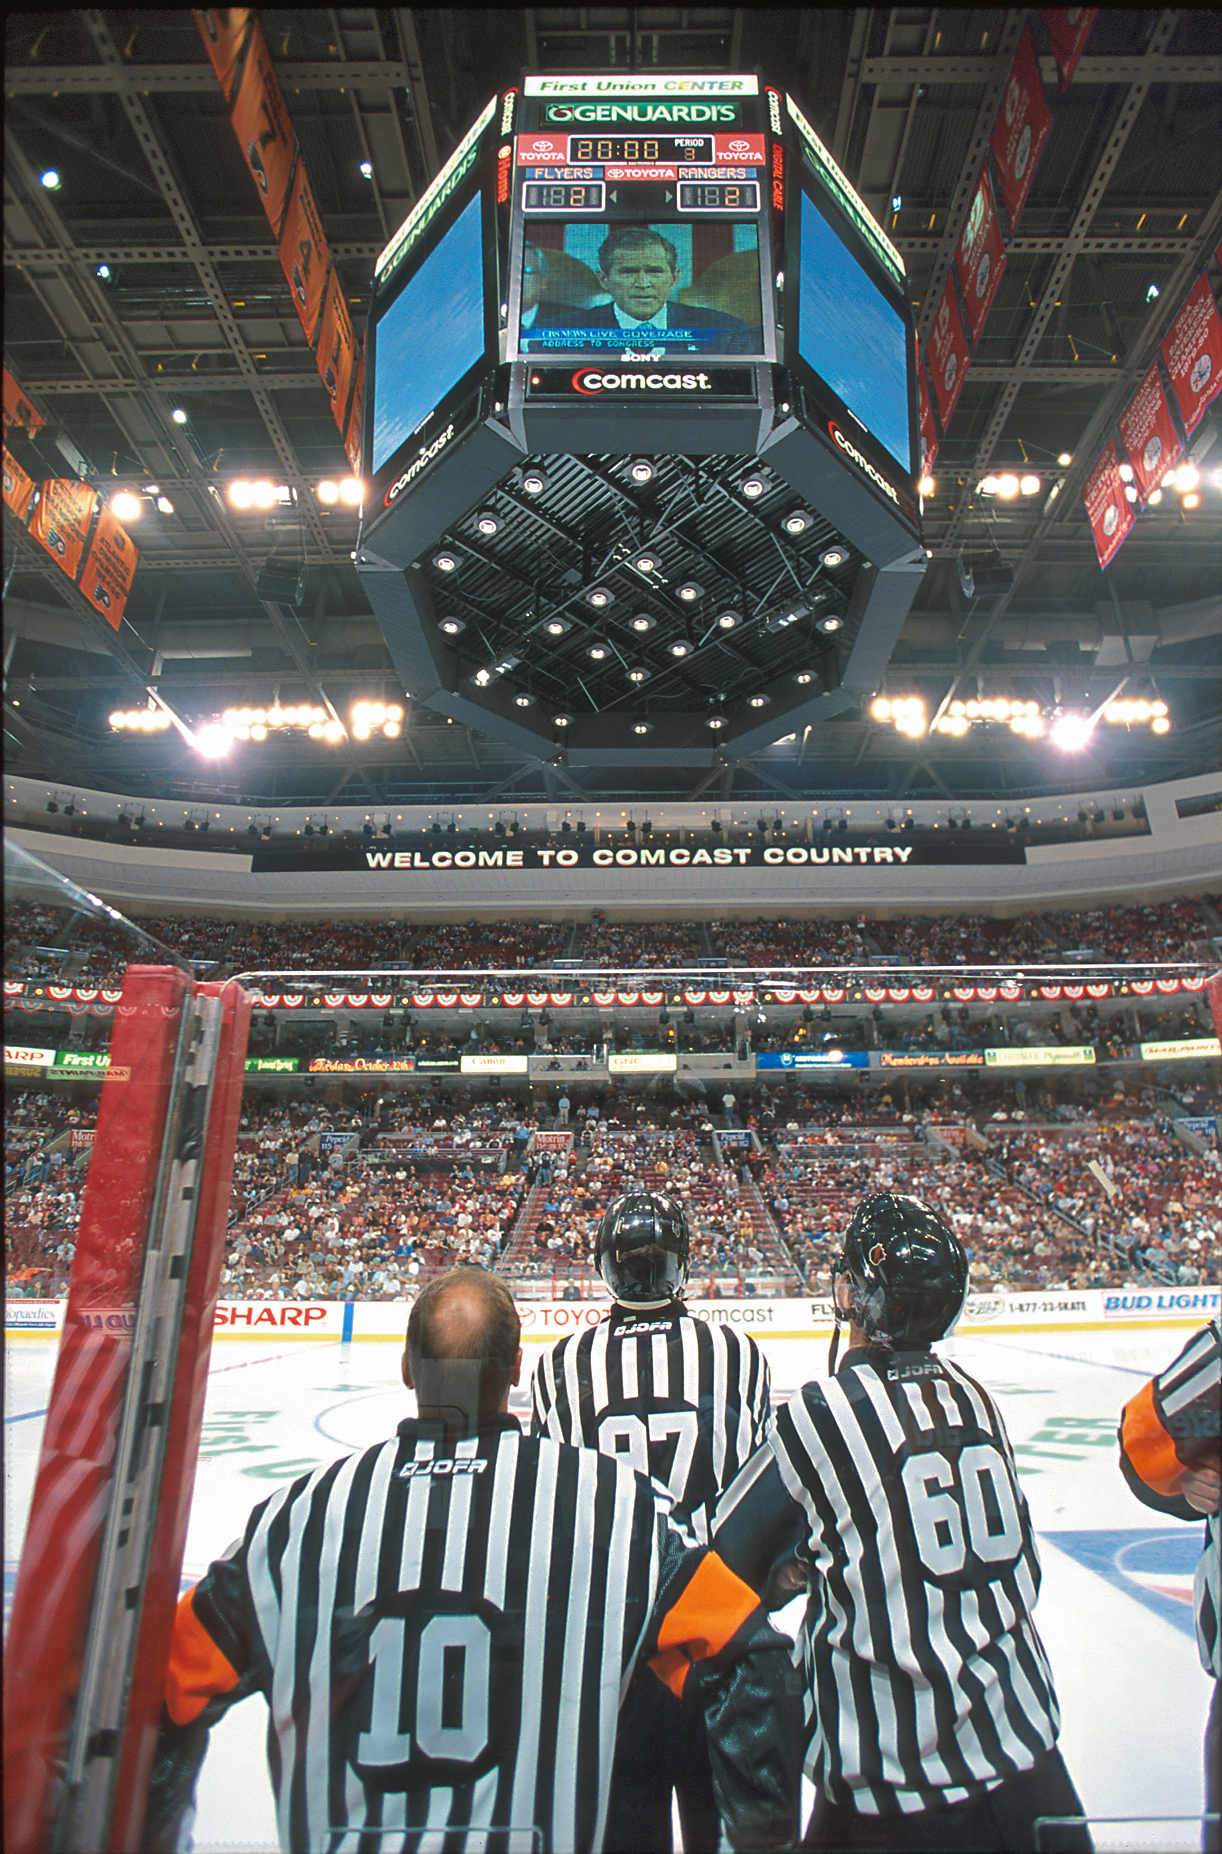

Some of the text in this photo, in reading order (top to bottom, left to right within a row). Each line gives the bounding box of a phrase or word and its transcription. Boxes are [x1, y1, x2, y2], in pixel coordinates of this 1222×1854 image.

[540, 80, 744, 91] First Union CENTER
[574, 105, 736, 121] GENUARDI'S
[577, 141, 659, 159] 20:00
[674, 139, 704, 147] PERIOD
[519, 152, 565, 161] TOYOTA
[716, 152, 763, 161] TOYOTA
[535, 168, 593, 179] FLYERS
[624, 169, 675, 178] TOYOTA
[679, 168, 746, 179] RANGERS
[772, 143, 784, 211] DIGITAL CABLE
[1168, 293, 1204, 357] EASTERN
[542, 340, 655, 348] ADDRESS TO CONGRESS
[1170, 303, 1215, 380] CHAMPIONS
[620, 354, 662, 362] SONY
[366, 846, 914, 869] WELCOME TO COMCAST COUNTRY
[62, 1053, 95, 1066] First
[355, 1058, 390, 1072] October
[1105, 1293, 1221, 1311] BUD LIGHT
[214, 1306, 327, 1326] SHARP
[598, 1411, 699, 1503] 97
[901, 1443, 1024, 1576] 60
[357, 1614, 491, 1766] 10
